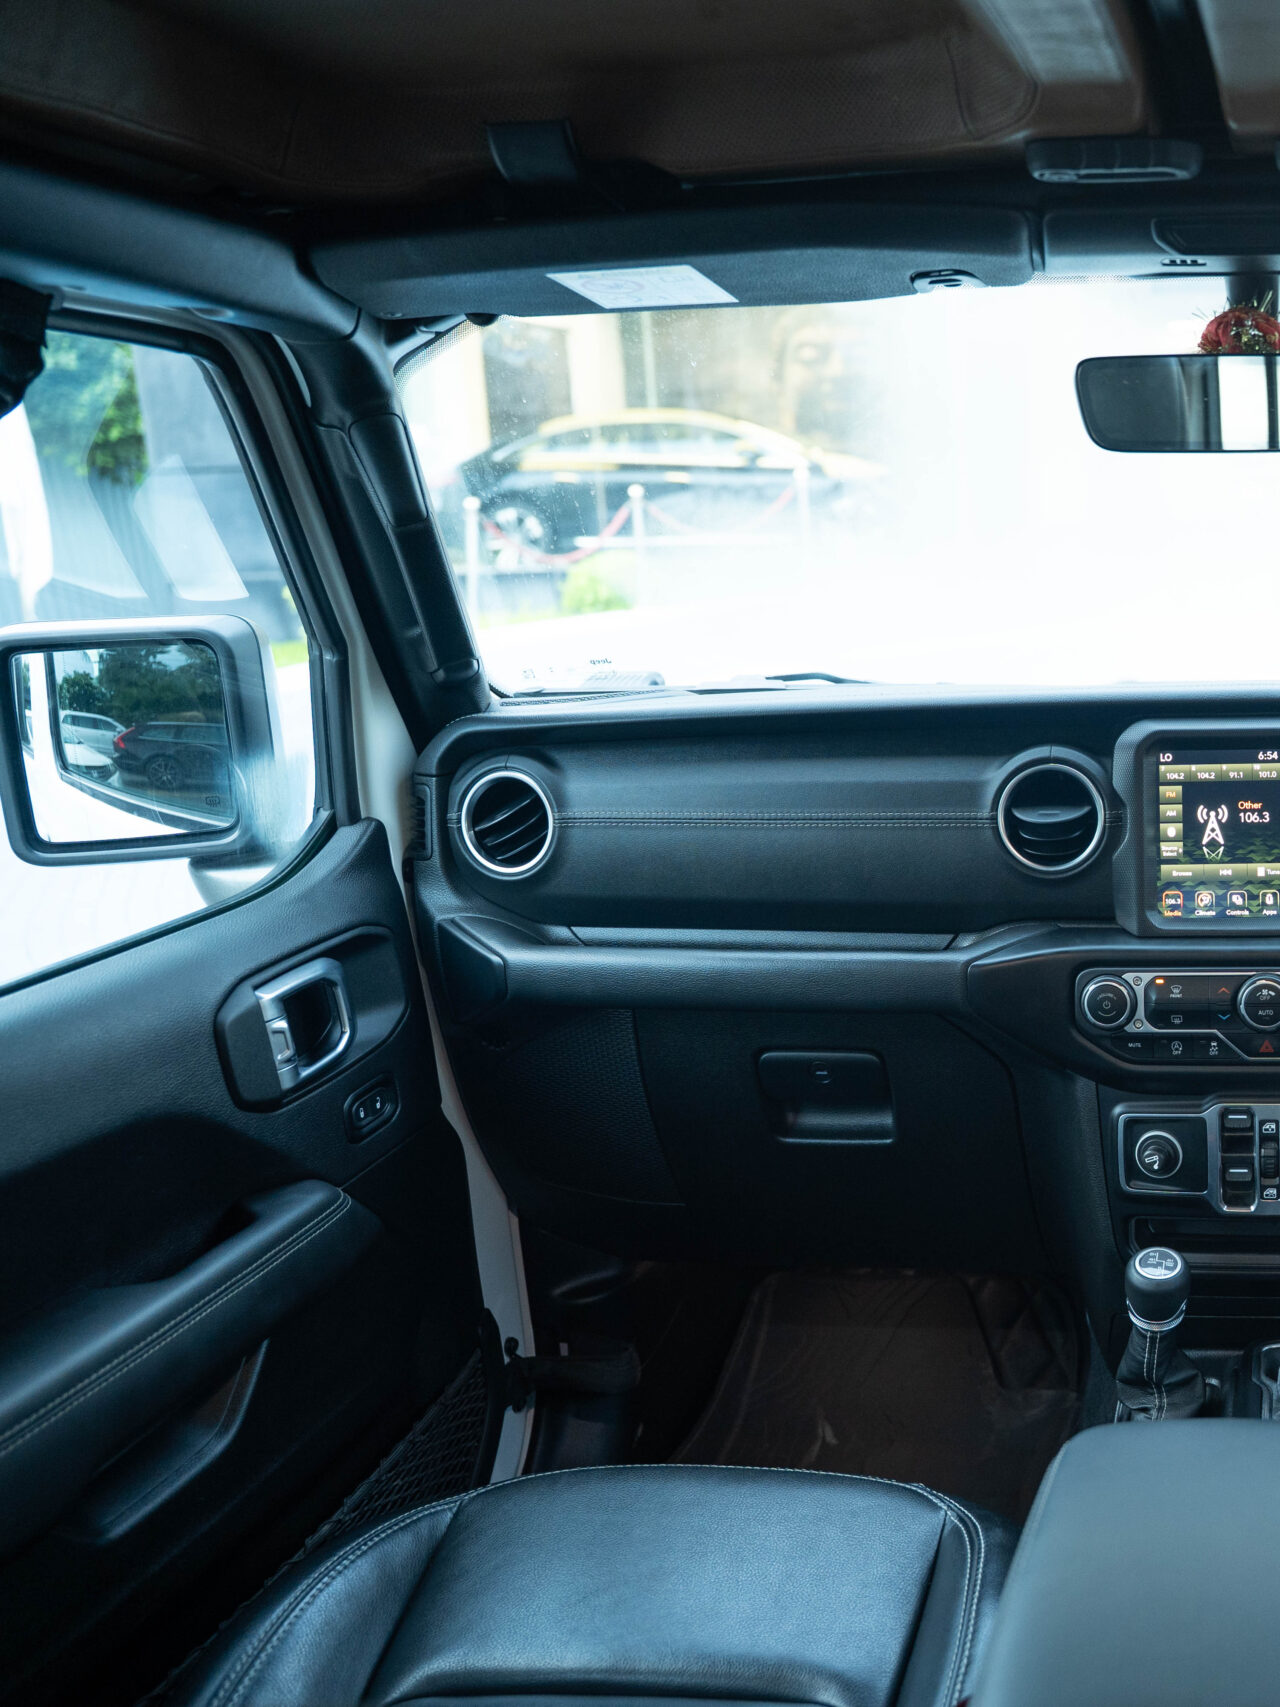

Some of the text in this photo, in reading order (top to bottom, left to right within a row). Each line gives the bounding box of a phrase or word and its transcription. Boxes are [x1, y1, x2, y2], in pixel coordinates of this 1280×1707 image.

[1160, 753, 1173, 762] LO
[1258, 751, 1278, 760] 6:54
[1166, 772, 1185, 780] 104.2
[1238, 800, 1263, 809] Other
[1239, 811, 1270, 823] 106.3
